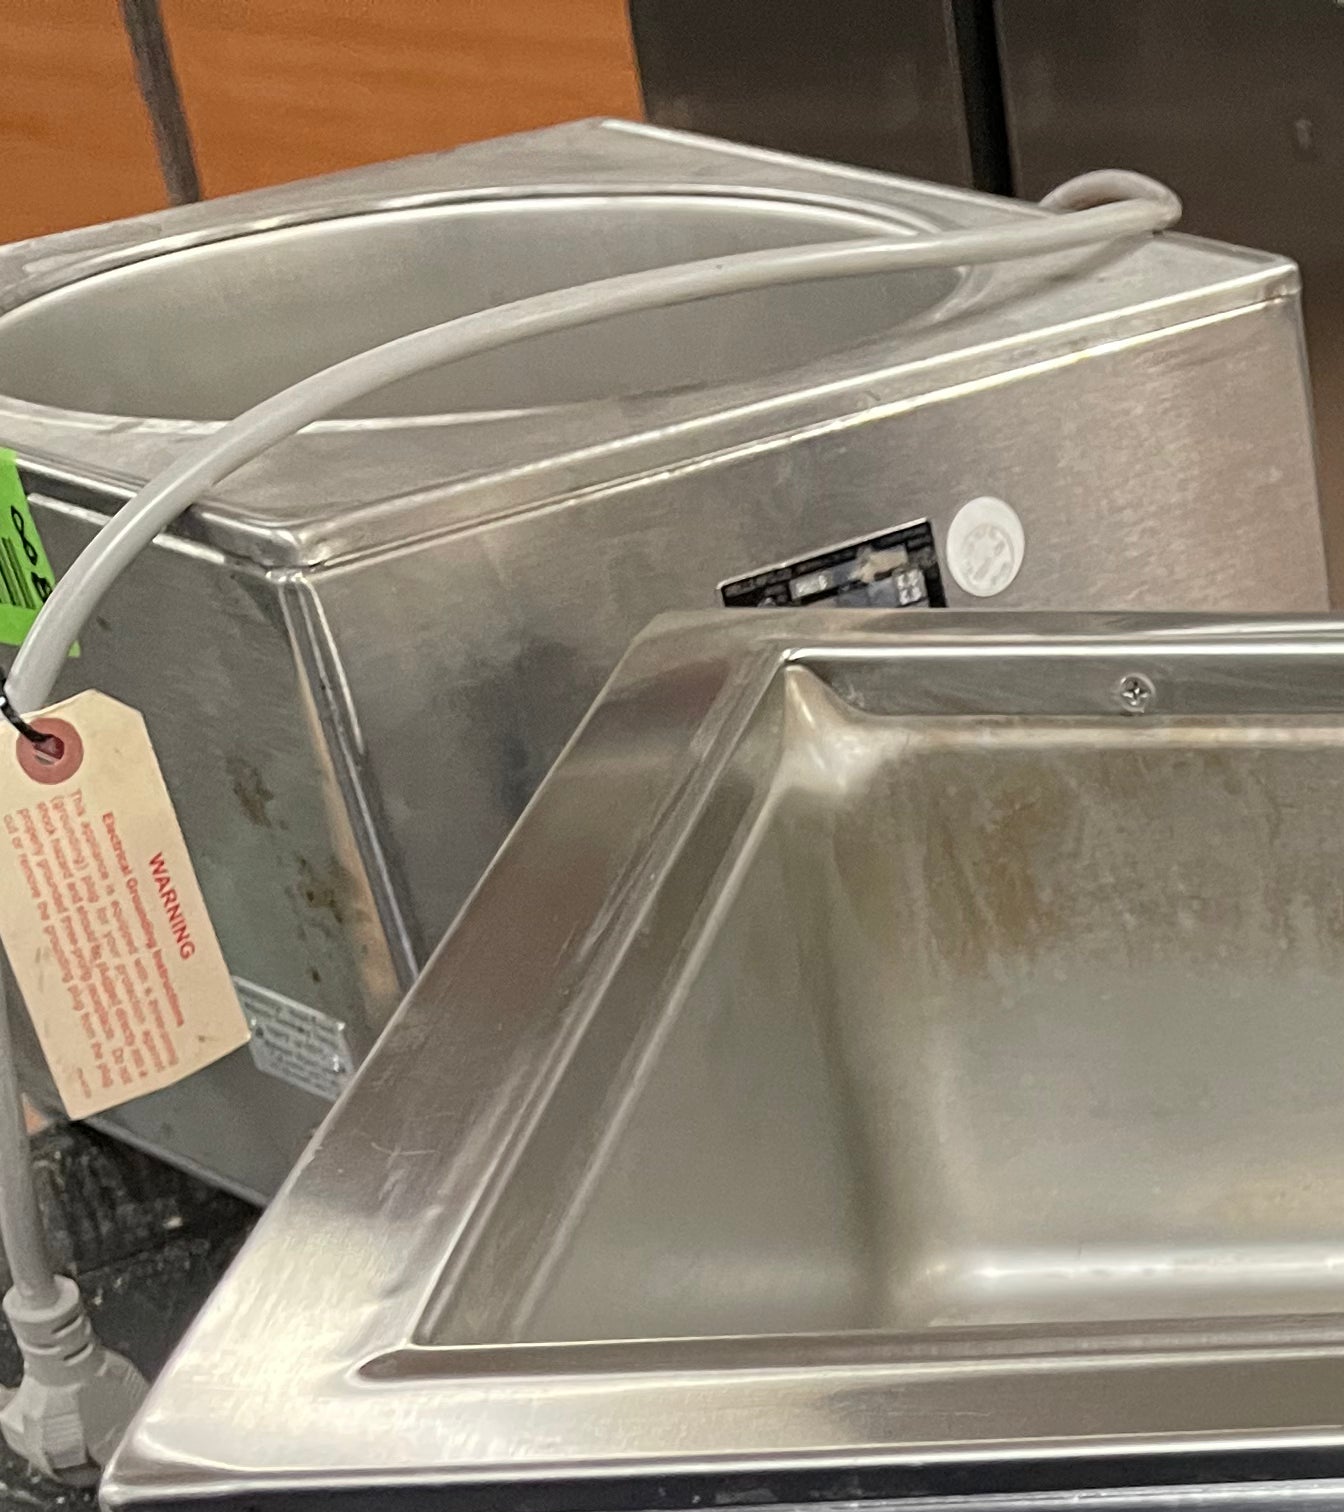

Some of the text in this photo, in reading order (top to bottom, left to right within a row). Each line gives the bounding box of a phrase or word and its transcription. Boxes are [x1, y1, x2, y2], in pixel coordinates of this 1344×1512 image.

[102, 812, 186, 1026] Electrical Grounding Instructions
[148, 852, 196, 960] WARNING
